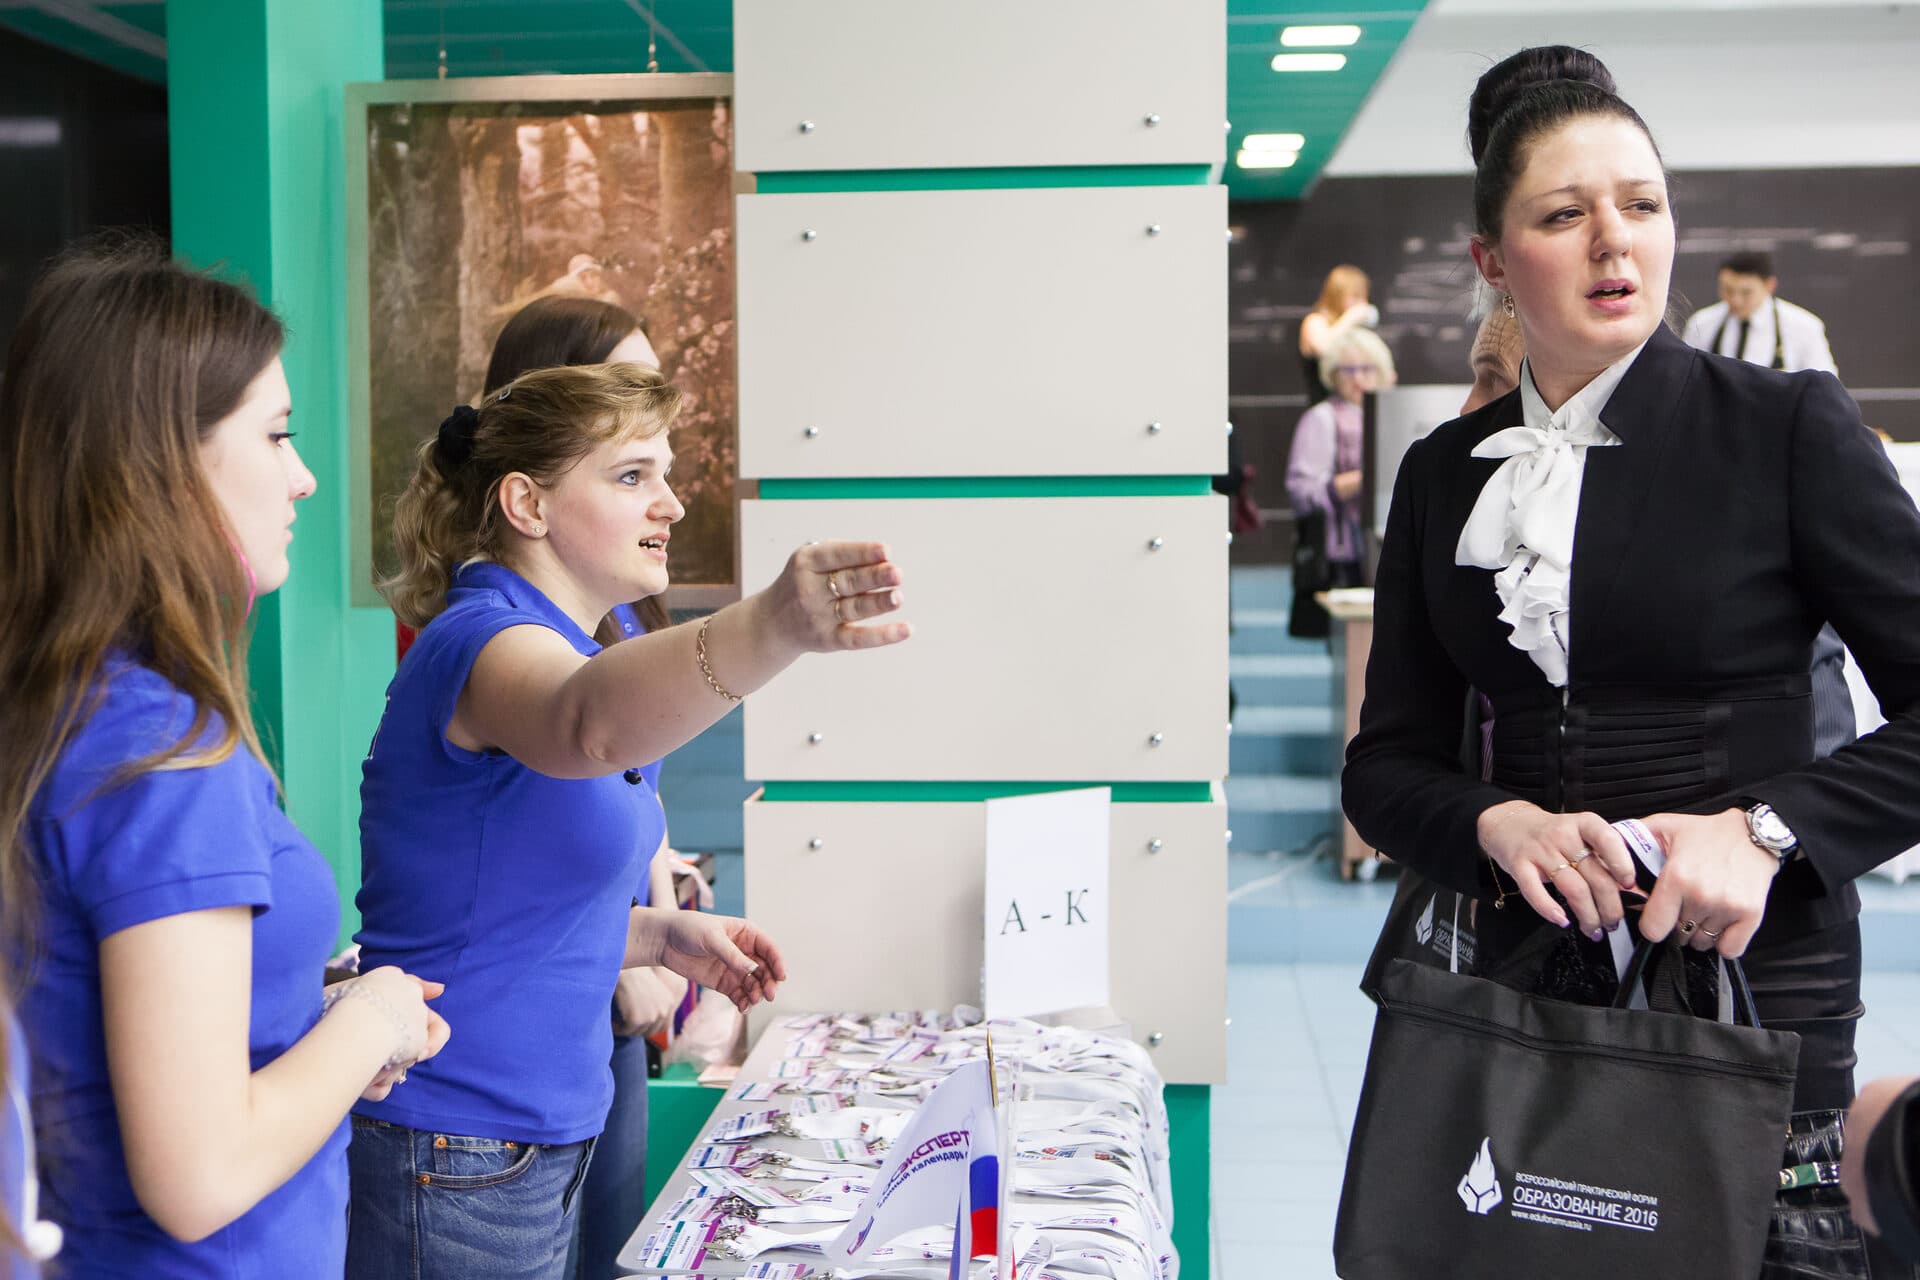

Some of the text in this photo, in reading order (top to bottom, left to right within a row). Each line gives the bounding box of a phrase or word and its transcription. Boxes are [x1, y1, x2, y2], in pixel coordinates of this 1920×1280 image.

[1000, 900, 1026, 935] А
[1066, 888, 1088, 925] К
[1513, 1186, 1658, 1227] ОБРАЗОВАНИЕ 2016
[1515, 1172, 1658, 1206] ВСЕРОССИЙСКИЙ ПРАКТИЧЕСКИЙ ФОРУМ
